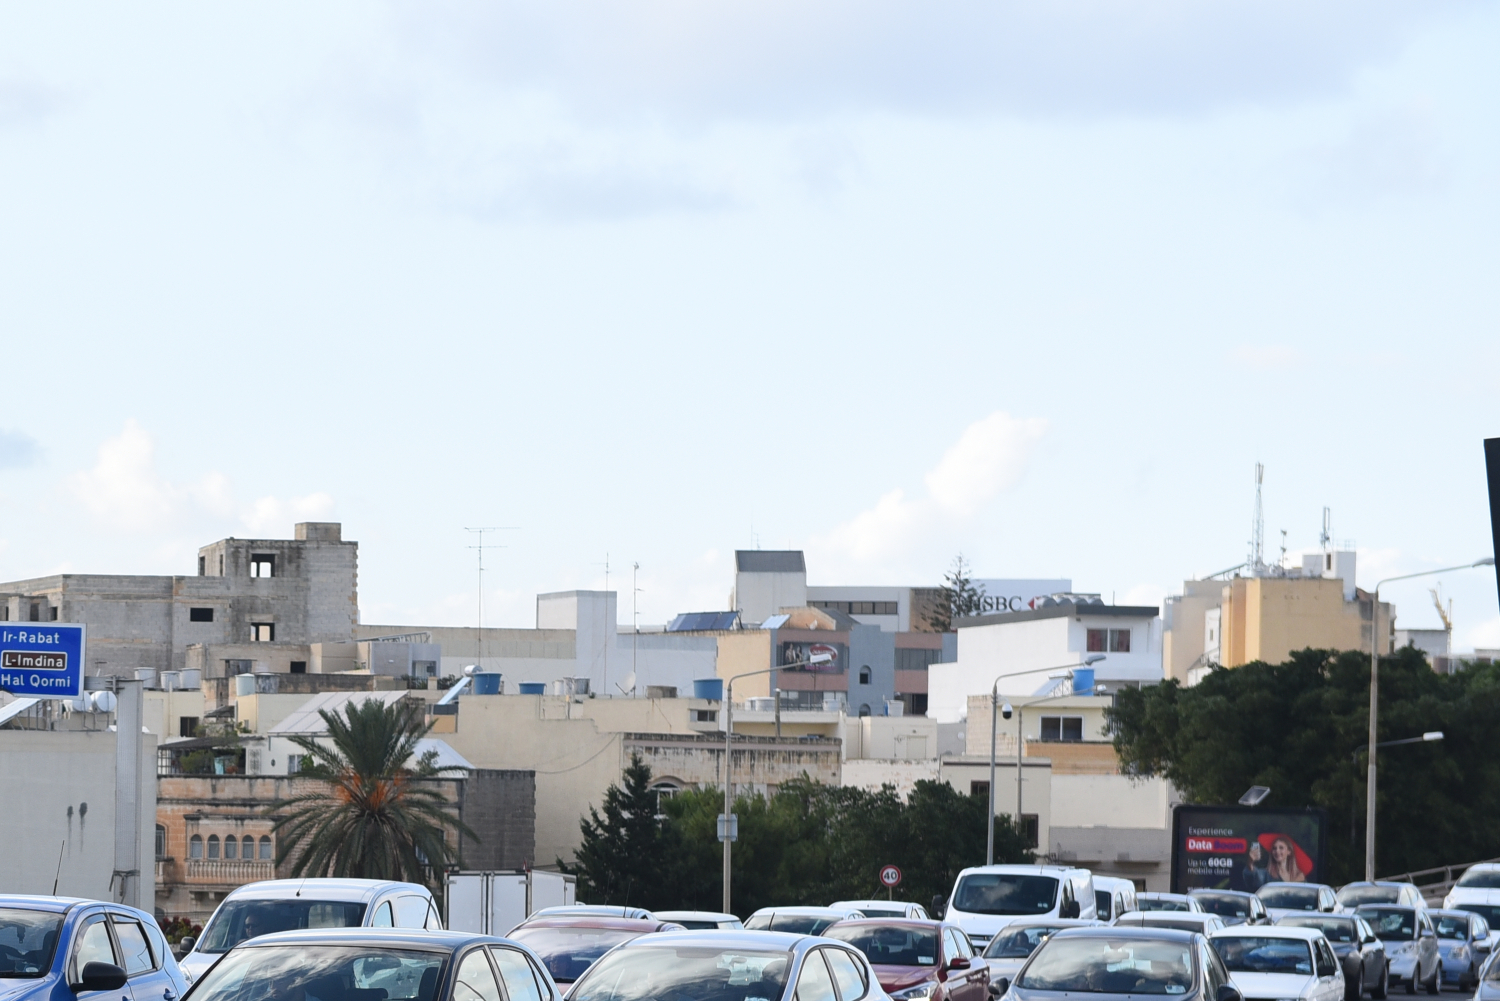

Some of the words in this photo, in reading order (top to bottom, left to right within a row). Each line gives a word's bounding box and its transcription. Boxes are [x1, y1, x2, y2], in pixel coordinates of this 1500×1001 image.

[2, 631, 60, 644] Ir-Rabat
[5, 654, 64, 667] L-Imdina
[30, 674, 71, 688] Qormi
[1188, 826, 1233, 837] Experience
[1188, 839, 1213, 851] Data
[1214, 840, 1244, 851] Boom
[1187, 859, 1198, 868] Up
[1208, 858, 1233, 868] 60GB
[884, 871, 898, 881] 40
[1187, 867, 1213, 875] mobile
[1214, 867, 1230, 876] data
